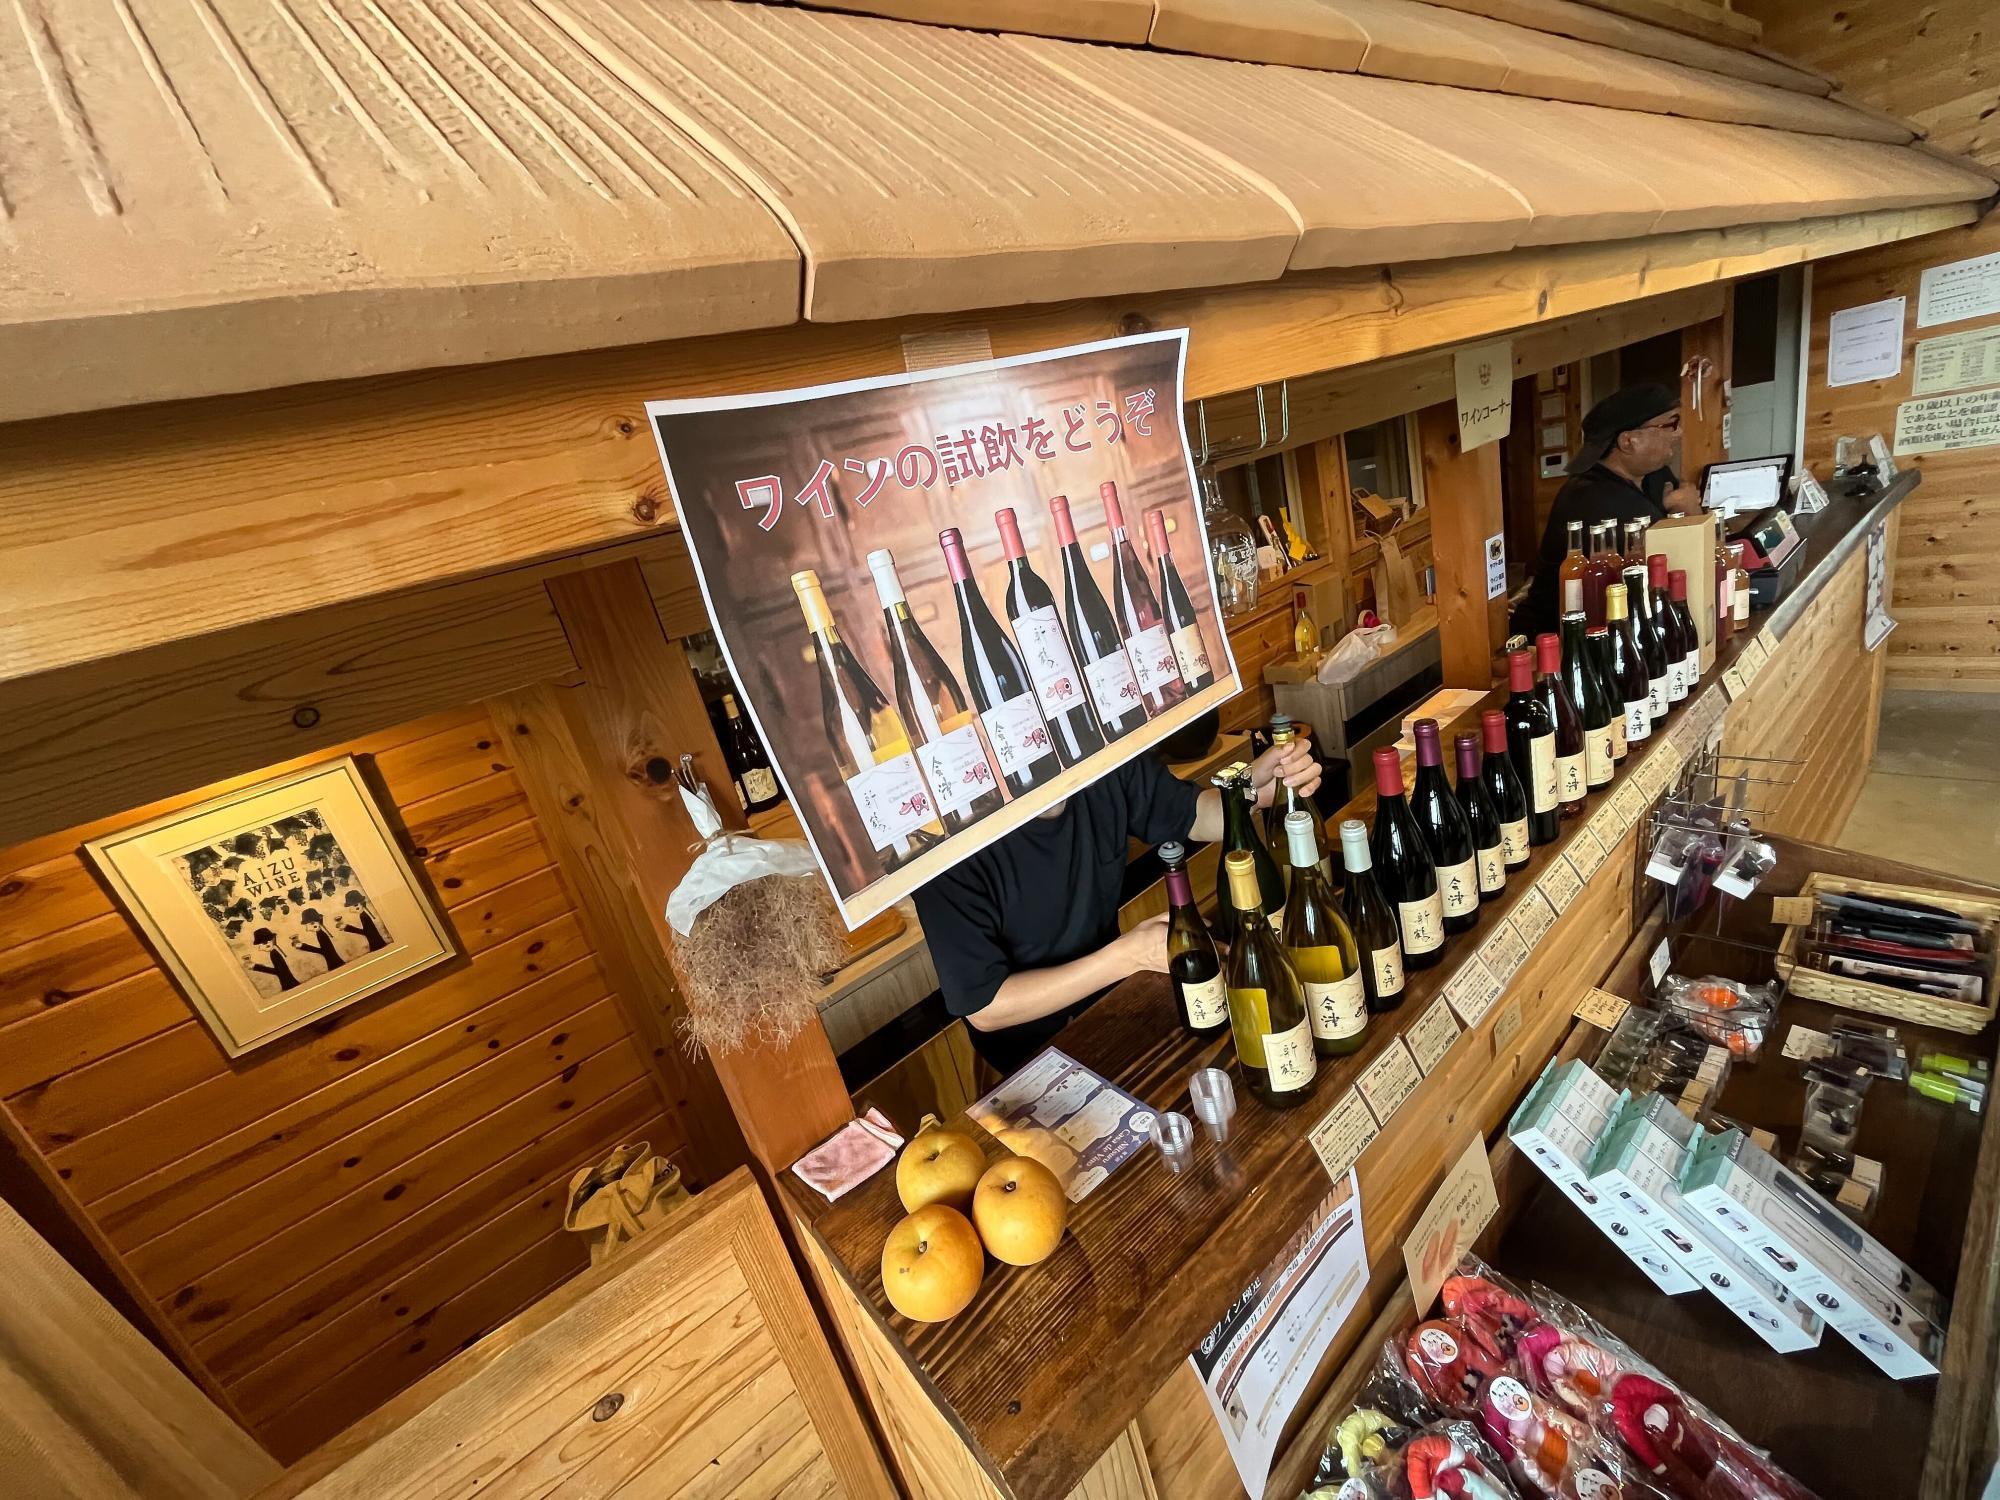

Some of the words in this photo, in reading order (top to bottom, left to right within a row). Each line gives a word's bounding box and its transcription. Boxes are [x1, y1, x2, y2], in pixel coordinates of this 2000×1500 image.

[1461, 398, 1511, 429] ワインコーナー
[735, 388, 1157, 532] ワインの試飲をどうぞ
[1566, 765, 1580, 792] 会津
[1502, 836, 1514, 857] 会津
[244, 858, 294, 886] AIZU
[246, 871, 301, 897] WINE
[1487, 861, 1498, 884] 会津
[1448, 876, 1464, 906] 会津
[1382, 963, 1396, 988] 会津
[1192, 997, 1207, 1021] 会津
[1319, 996, 1342, 1029] 会津
[1103, 1144, 1113, 1153] de
[1111, 1128, 1131, 1145] Casa
[1086, 1153, 1105, 1167] Vino
[1102, 1140, 1130, 1164] Niitsuru
[1213, 1276, 1262, 1339] ワイン検定
